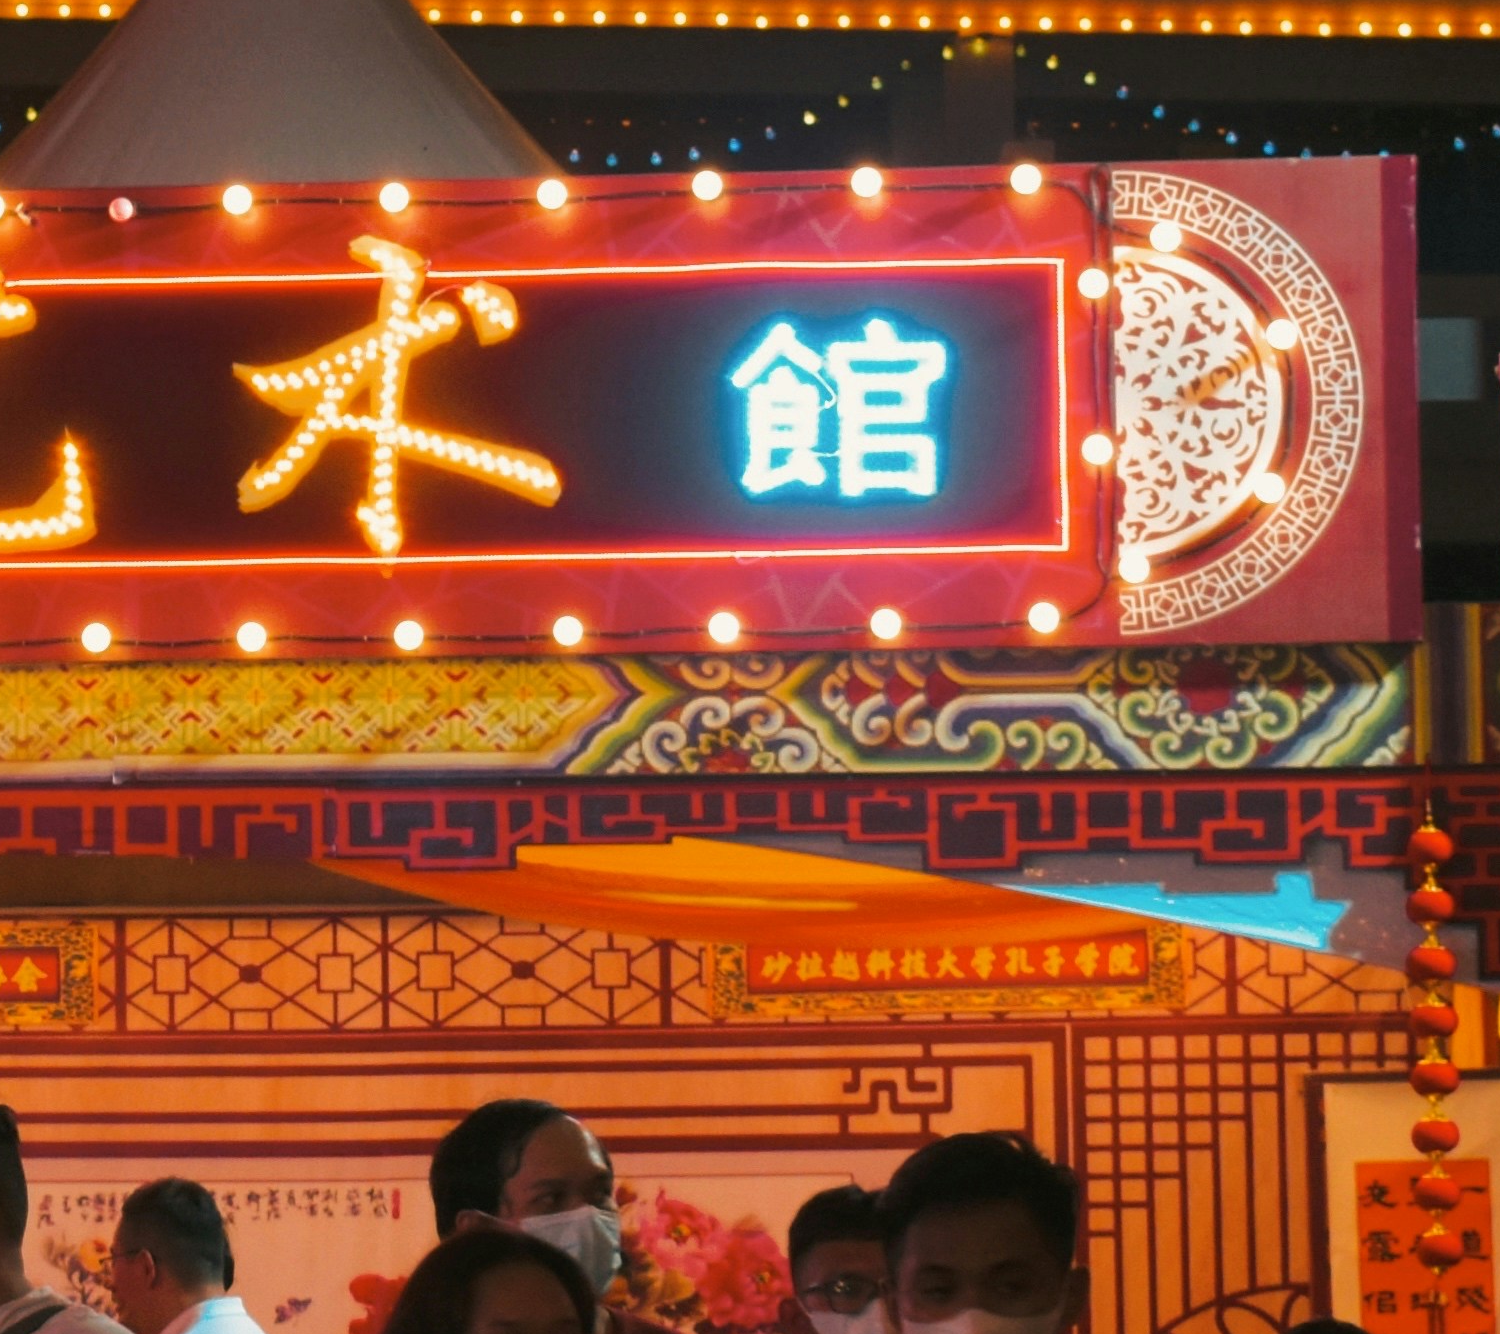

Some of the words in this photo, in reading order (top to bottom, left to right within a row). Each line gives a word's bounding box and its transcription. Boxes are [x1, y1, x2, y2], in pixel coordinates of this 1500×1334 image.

[760, 941, 1141, 985] 砂拉越科技大学孔子学院
